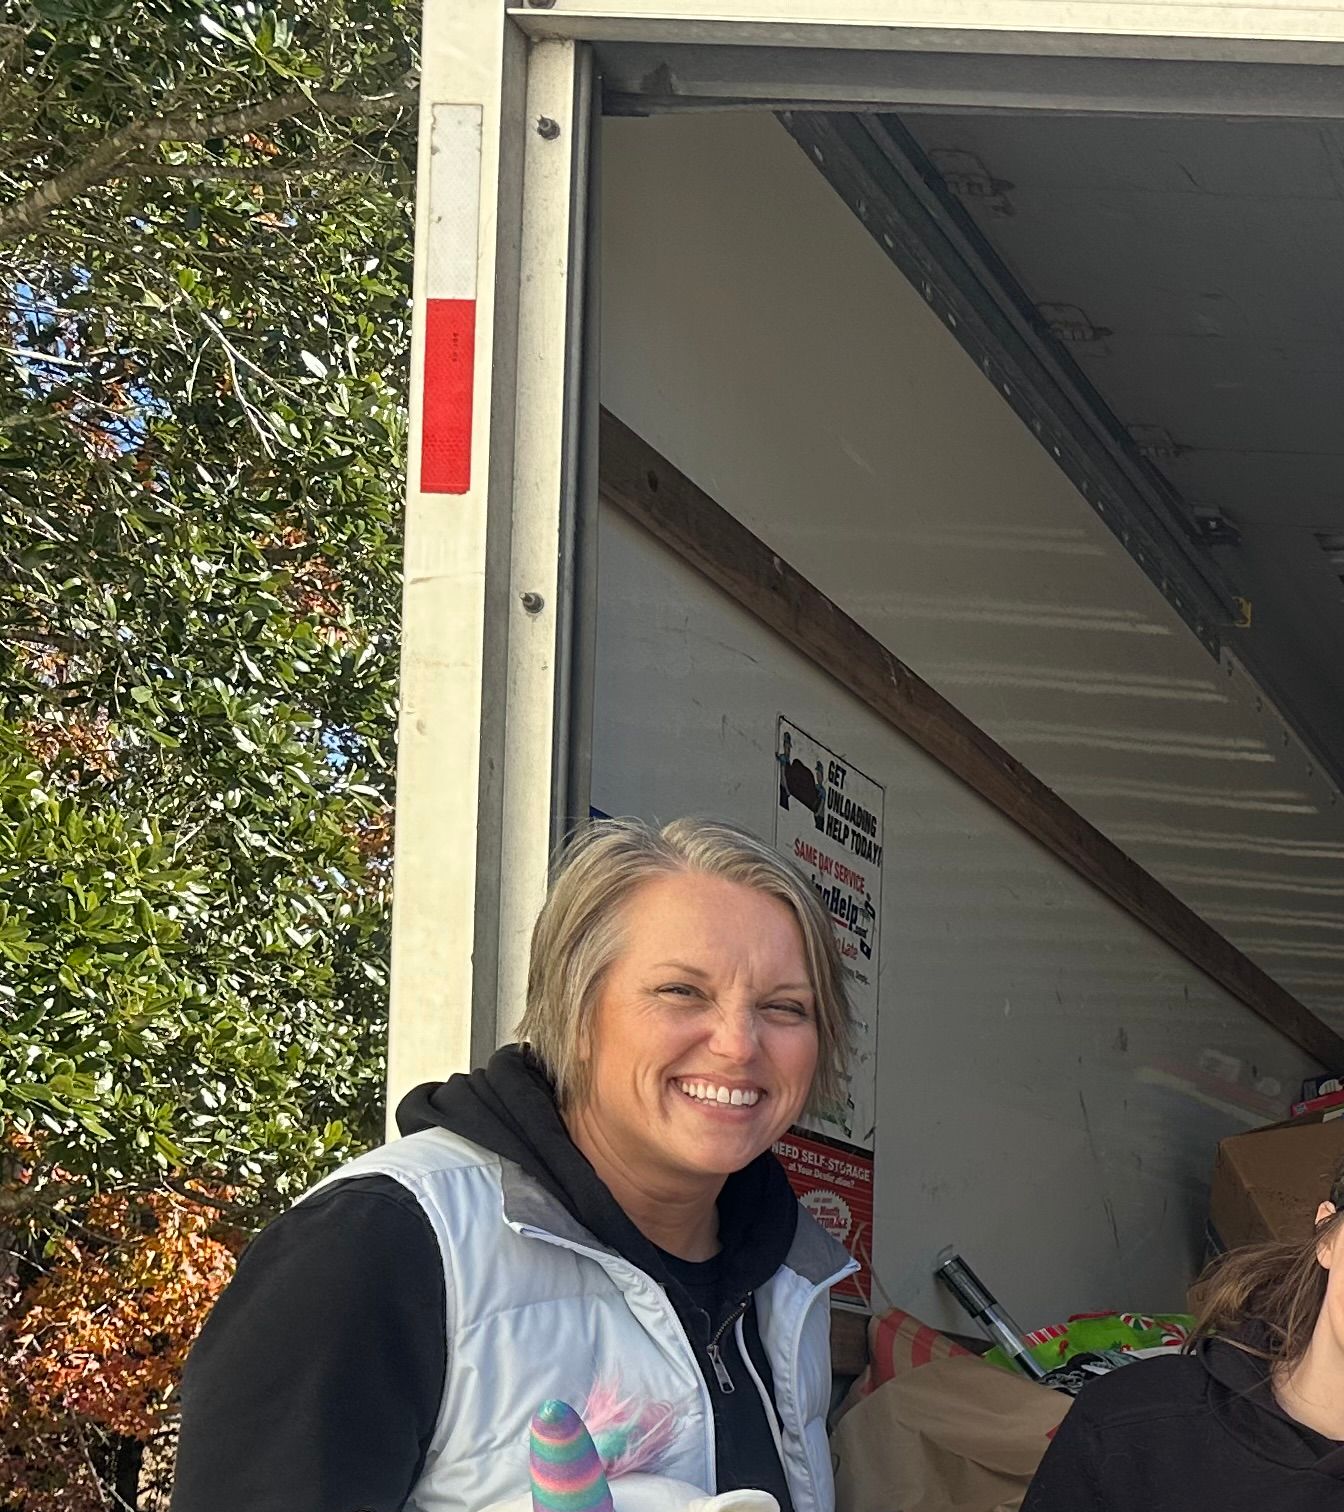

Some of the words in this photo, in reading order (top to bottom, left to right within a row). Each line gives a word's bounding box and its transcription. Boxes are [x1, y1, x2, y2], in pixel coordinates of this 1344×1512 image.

[828, 760, 847, 790] GET
[827, 789, 877, 838] UNLOADING
[826, 813, 850, 846] HELP
[850, 829, 883, 868] TODAY!
[794, 838, 817, 867] SAME
[818, 856, 834, 875] DAY
[834, 861, 865, 895] SERVICE
[771, 1141, 799, 1160] NEED
[801, 1149, 871, 1182] SELF-STORAGE
